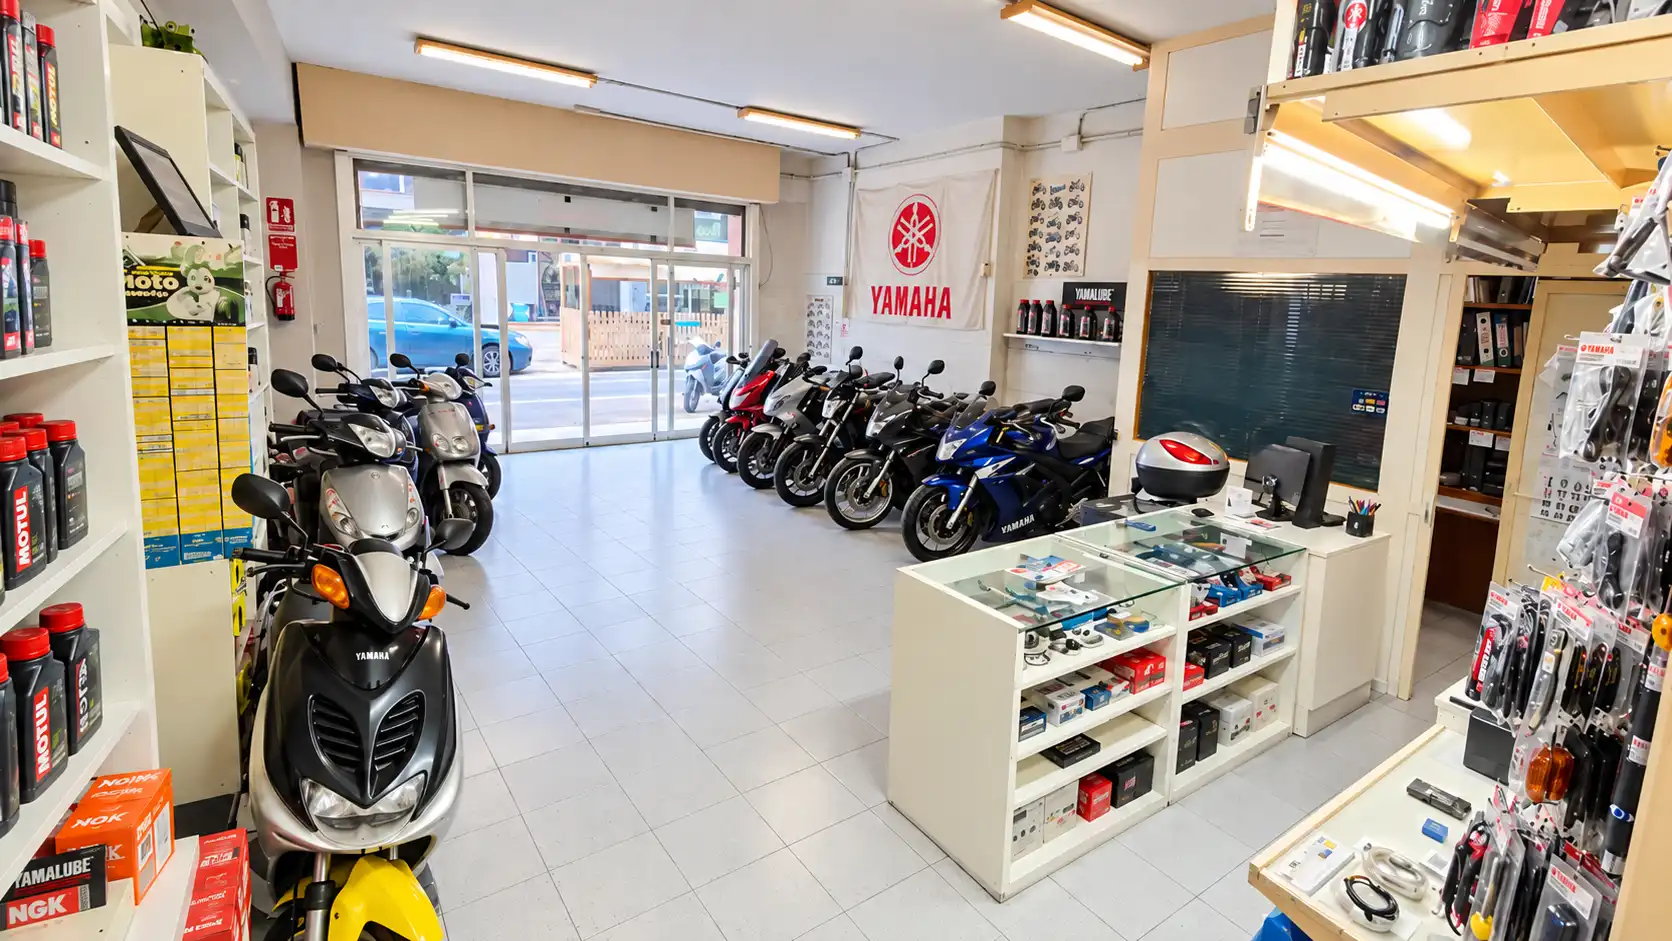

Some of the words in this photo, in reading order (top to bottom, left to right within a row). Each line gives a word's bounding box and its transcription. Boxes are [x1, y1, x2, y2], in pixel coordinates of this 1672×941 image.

[871, 285, 951, 320] YAMAHA
[1075, 288, 1112, 301] YAMALUBE
[16, 491, 31, 565] MOTUL
[1001, 513, 1035, 534] YAMAHA
[355, 651, 390, 660] YAMAHA
[36, 694, 50, 774] MOTUL
[15, 857, 92, 889] YAMALUBE
[9, 894, 67, 925] NGK
